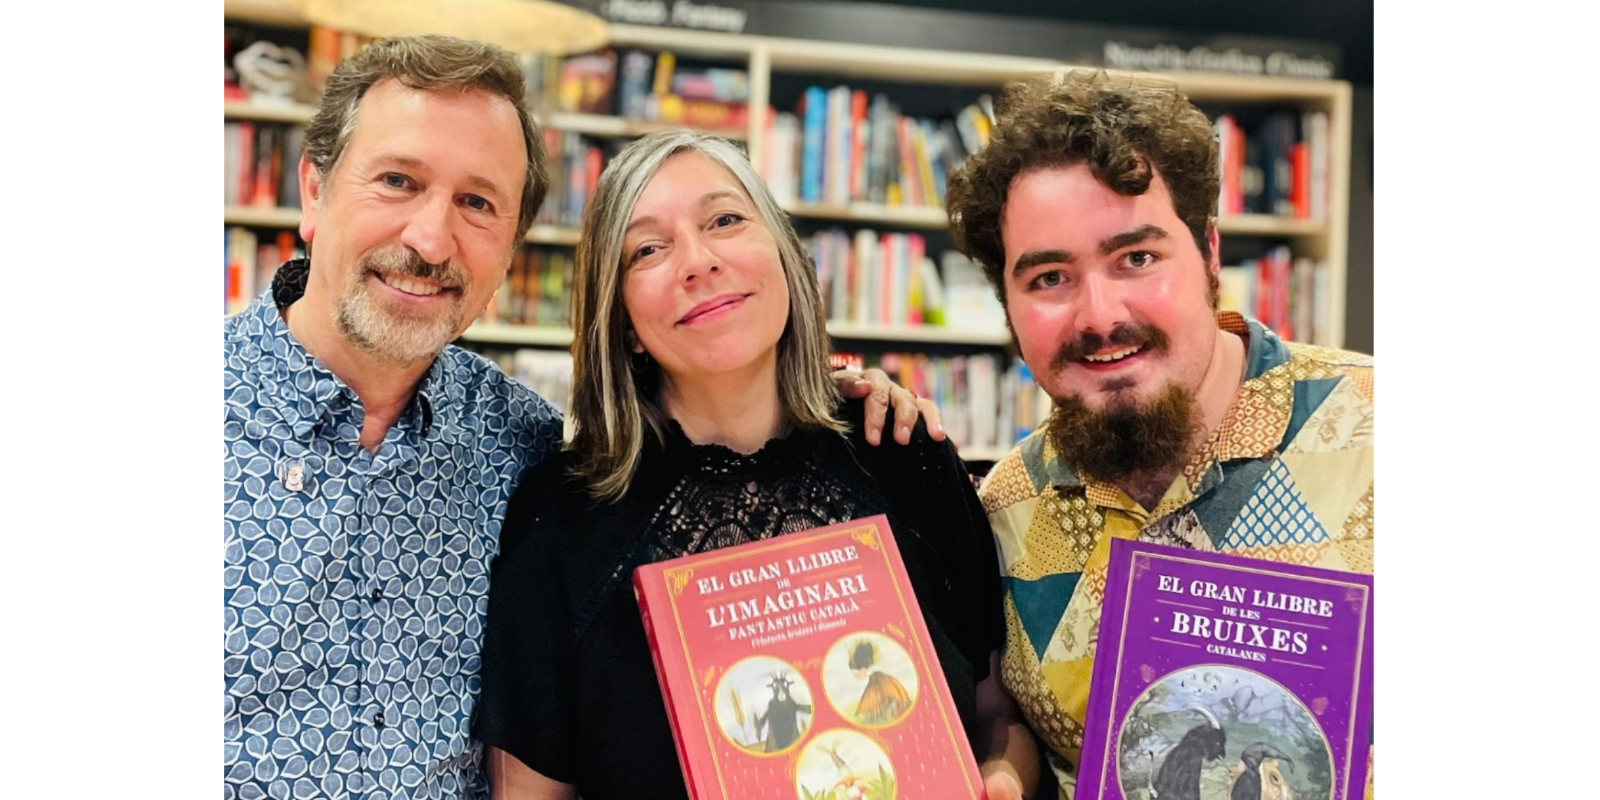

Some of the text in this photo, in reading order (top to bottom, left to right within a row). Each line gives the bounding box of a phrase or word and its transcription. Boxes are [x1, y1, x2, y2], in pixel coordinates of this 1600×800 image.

[696, 545, 859, 595] EL GRAN LLIBRE
[776, 578, 791, 590] DE
[706, 574, 868, 628] L'IMAGINARI
[1157, 574, 1334, 618] EL GRAN LLIBRE
[1222, 606, 1261, 620] DE LES
[728, 597, 860, 640] FANTÀSTIC CATALÀ
[1170, 611, 1309, 655] BRUIXES
[1206, 643, 1267, 662] CATALANES
